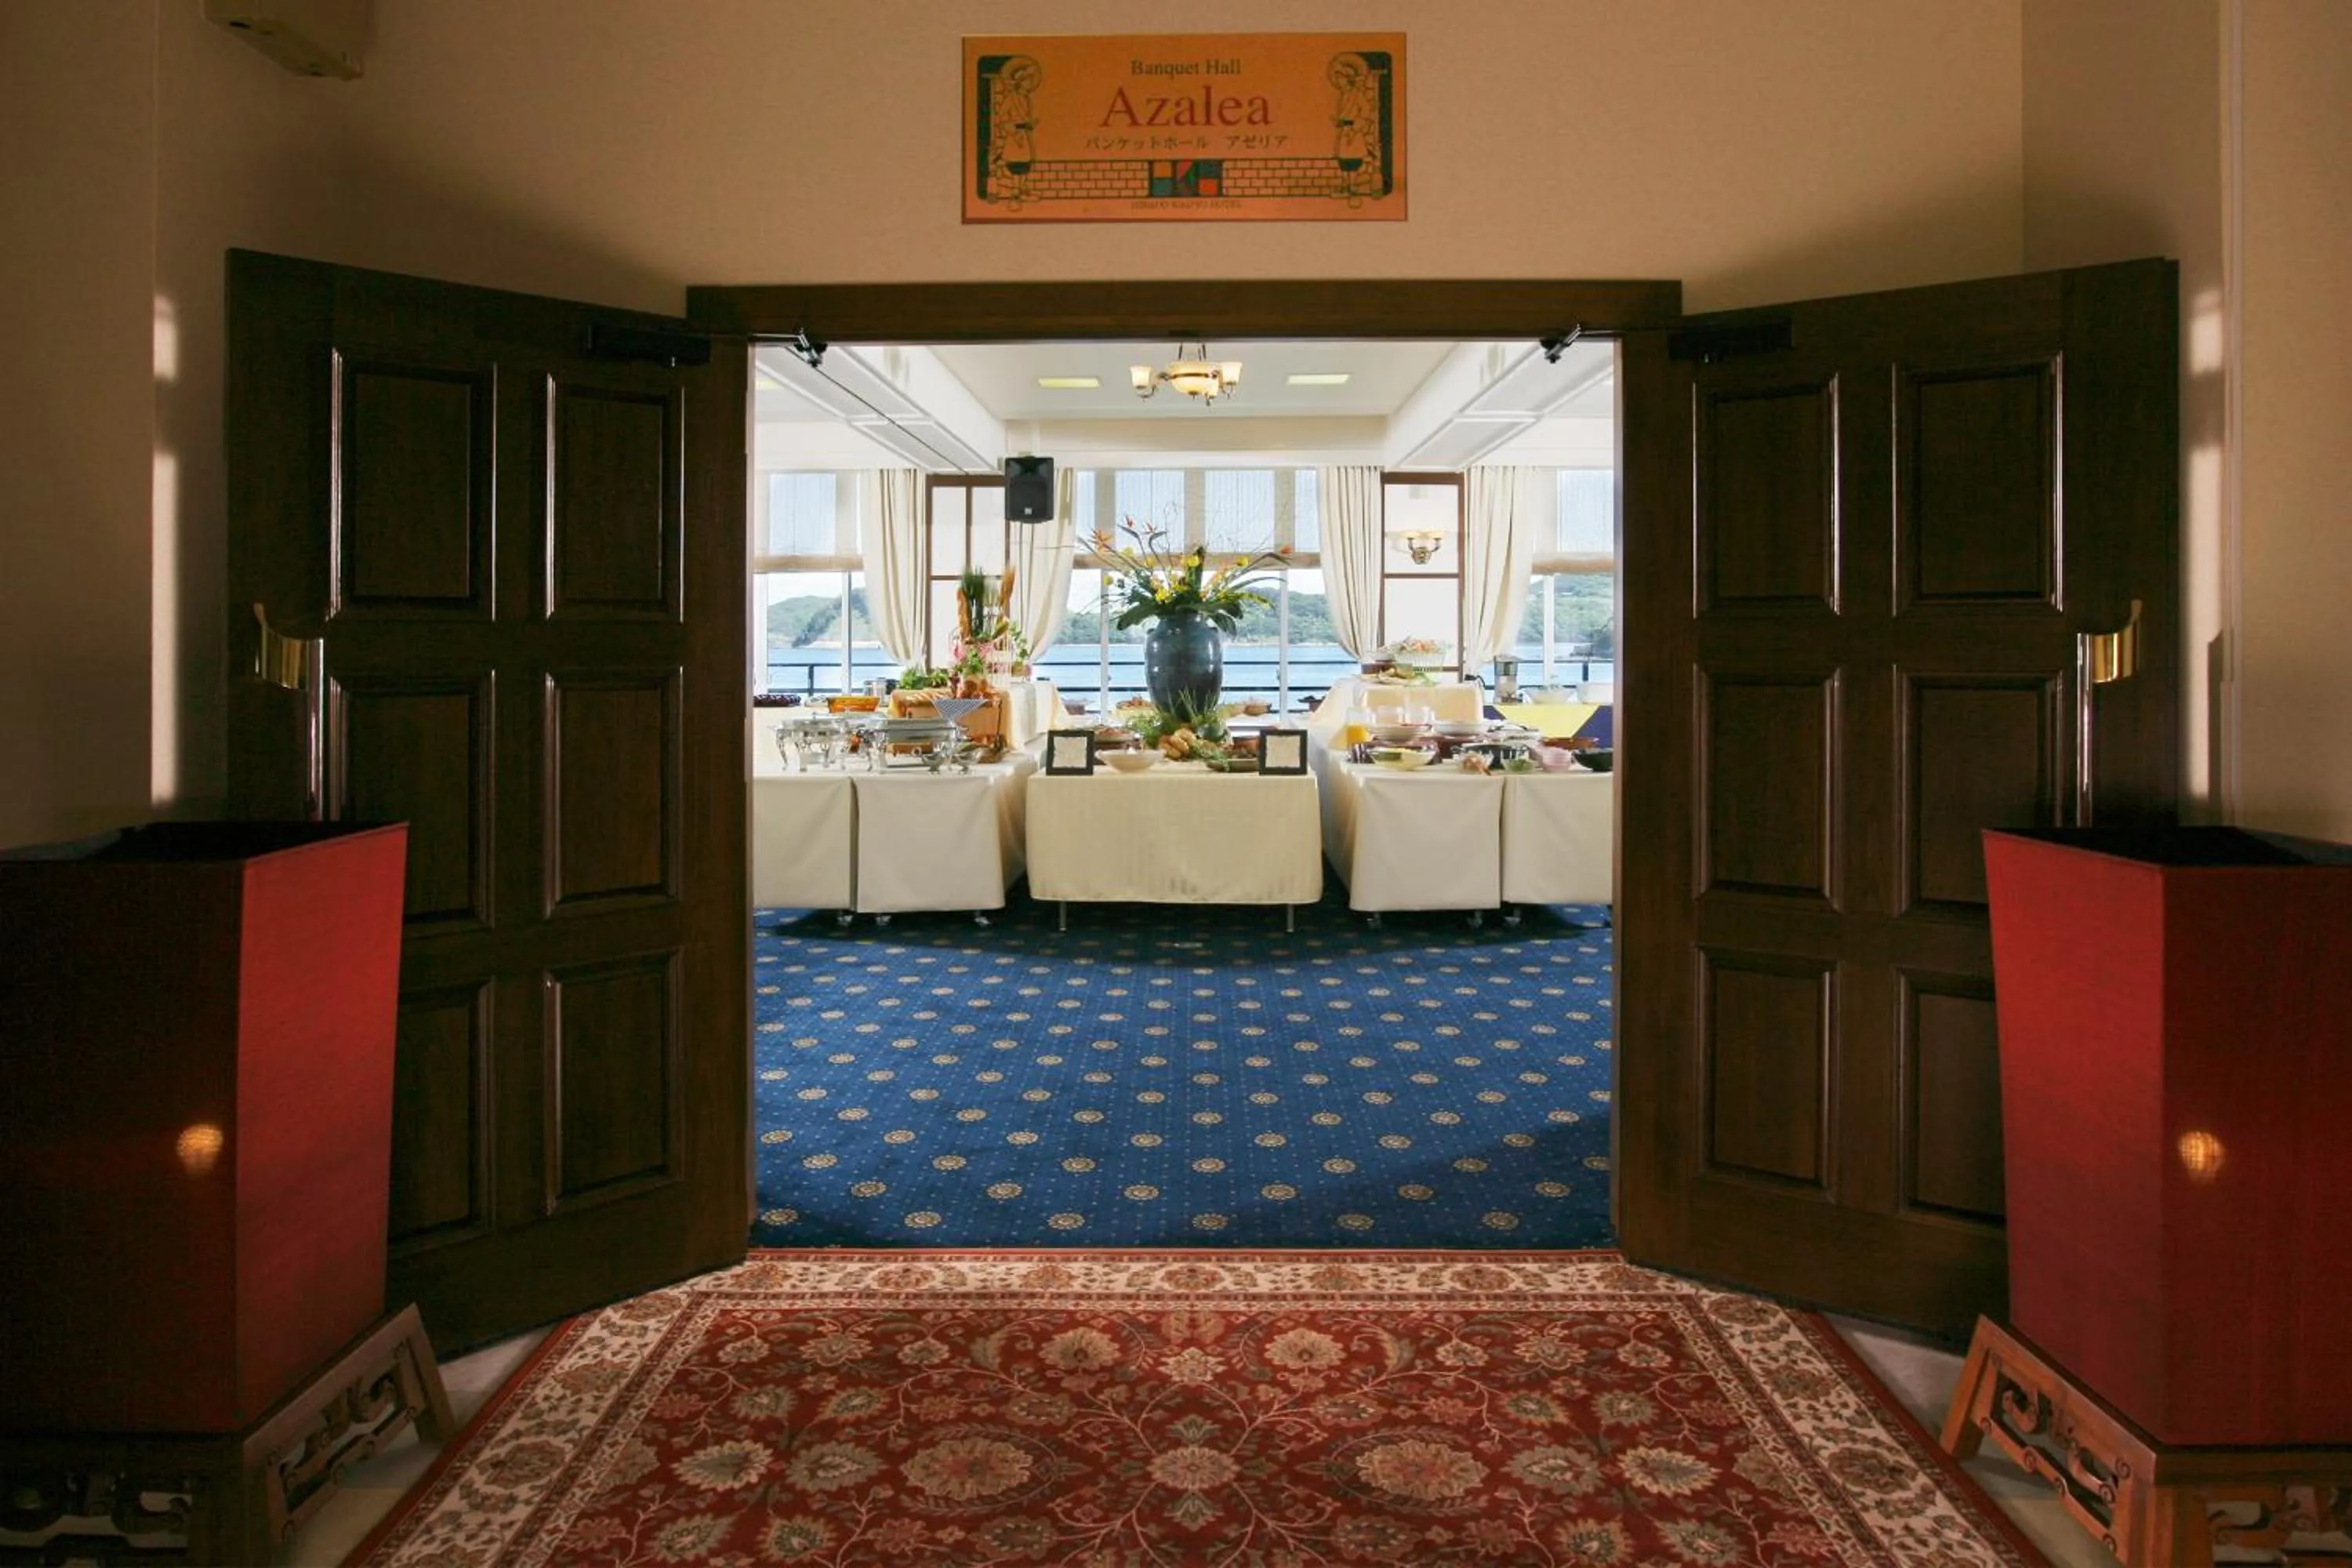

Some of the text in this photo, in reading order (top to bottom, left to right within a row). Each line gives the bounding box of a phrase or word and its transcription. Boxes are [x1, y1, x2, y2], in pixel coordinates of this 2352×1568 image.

[1131, 58, 1241, 79] Banquet Hall
[1099, 85, 1272, 128] Azalea
[1085, 135, 1288, 151] バンケットホール アゼリア
